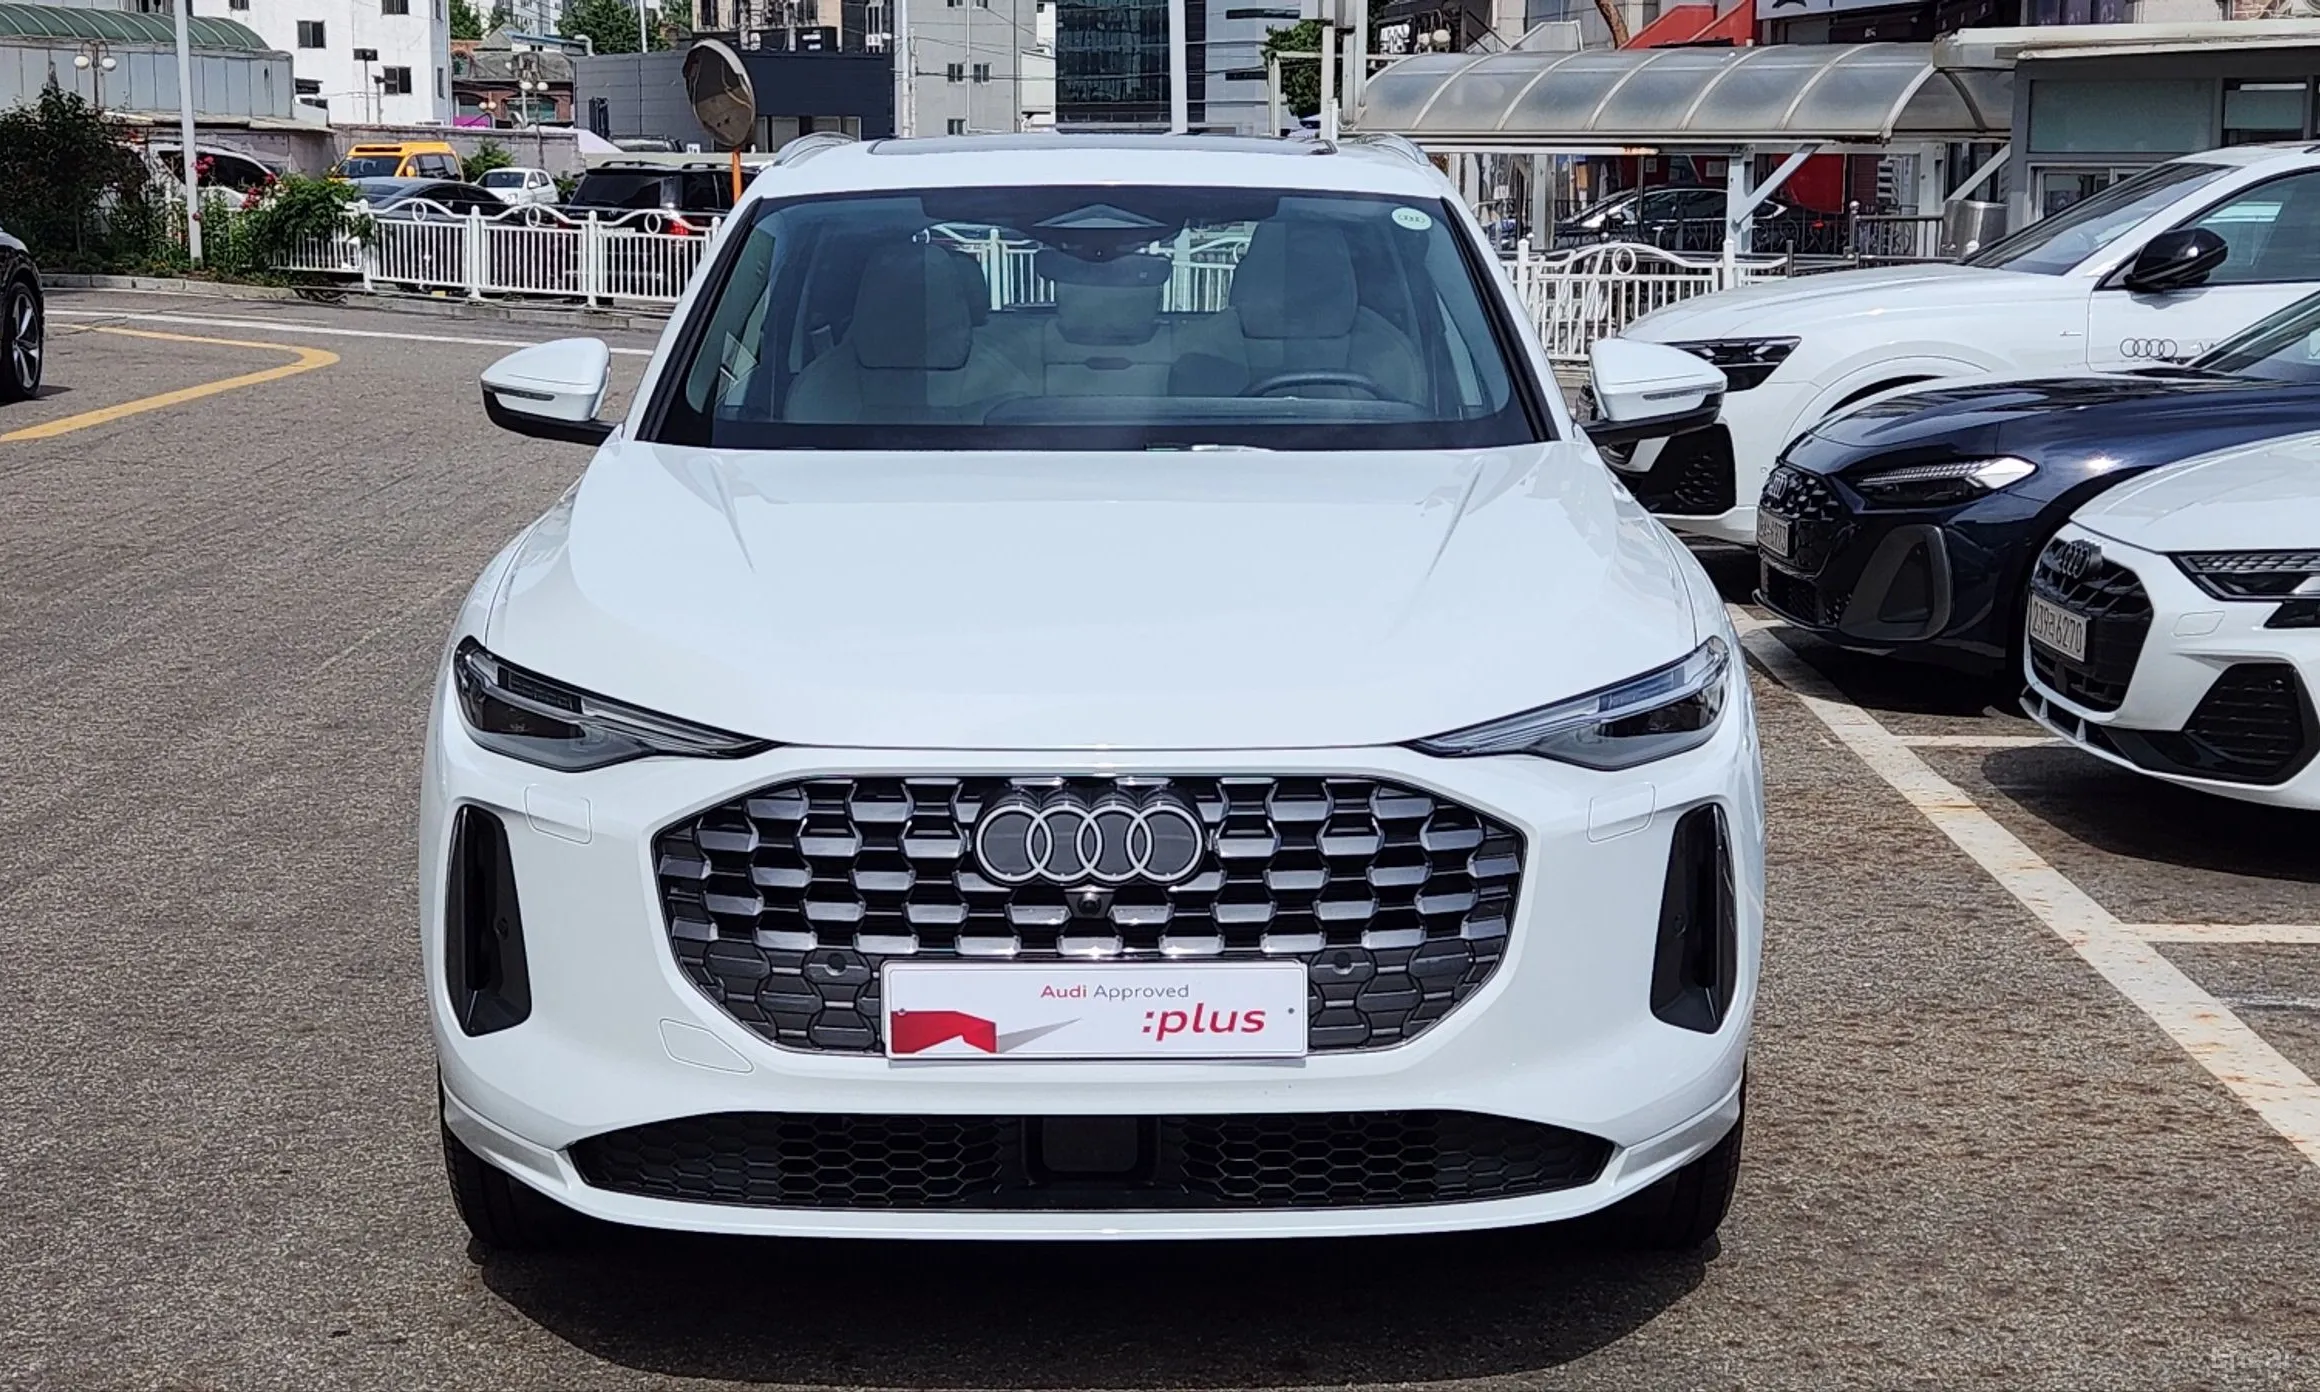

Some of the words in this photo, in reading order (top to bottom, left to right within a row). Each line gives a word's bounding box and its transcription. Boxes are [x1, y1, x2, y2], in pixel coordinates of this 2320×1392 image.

[1040, 984, 1087, 999] Audi
[1093, 984, 1190, 1002] Approved
[1142, 1002, 1266, 1042] :plus
